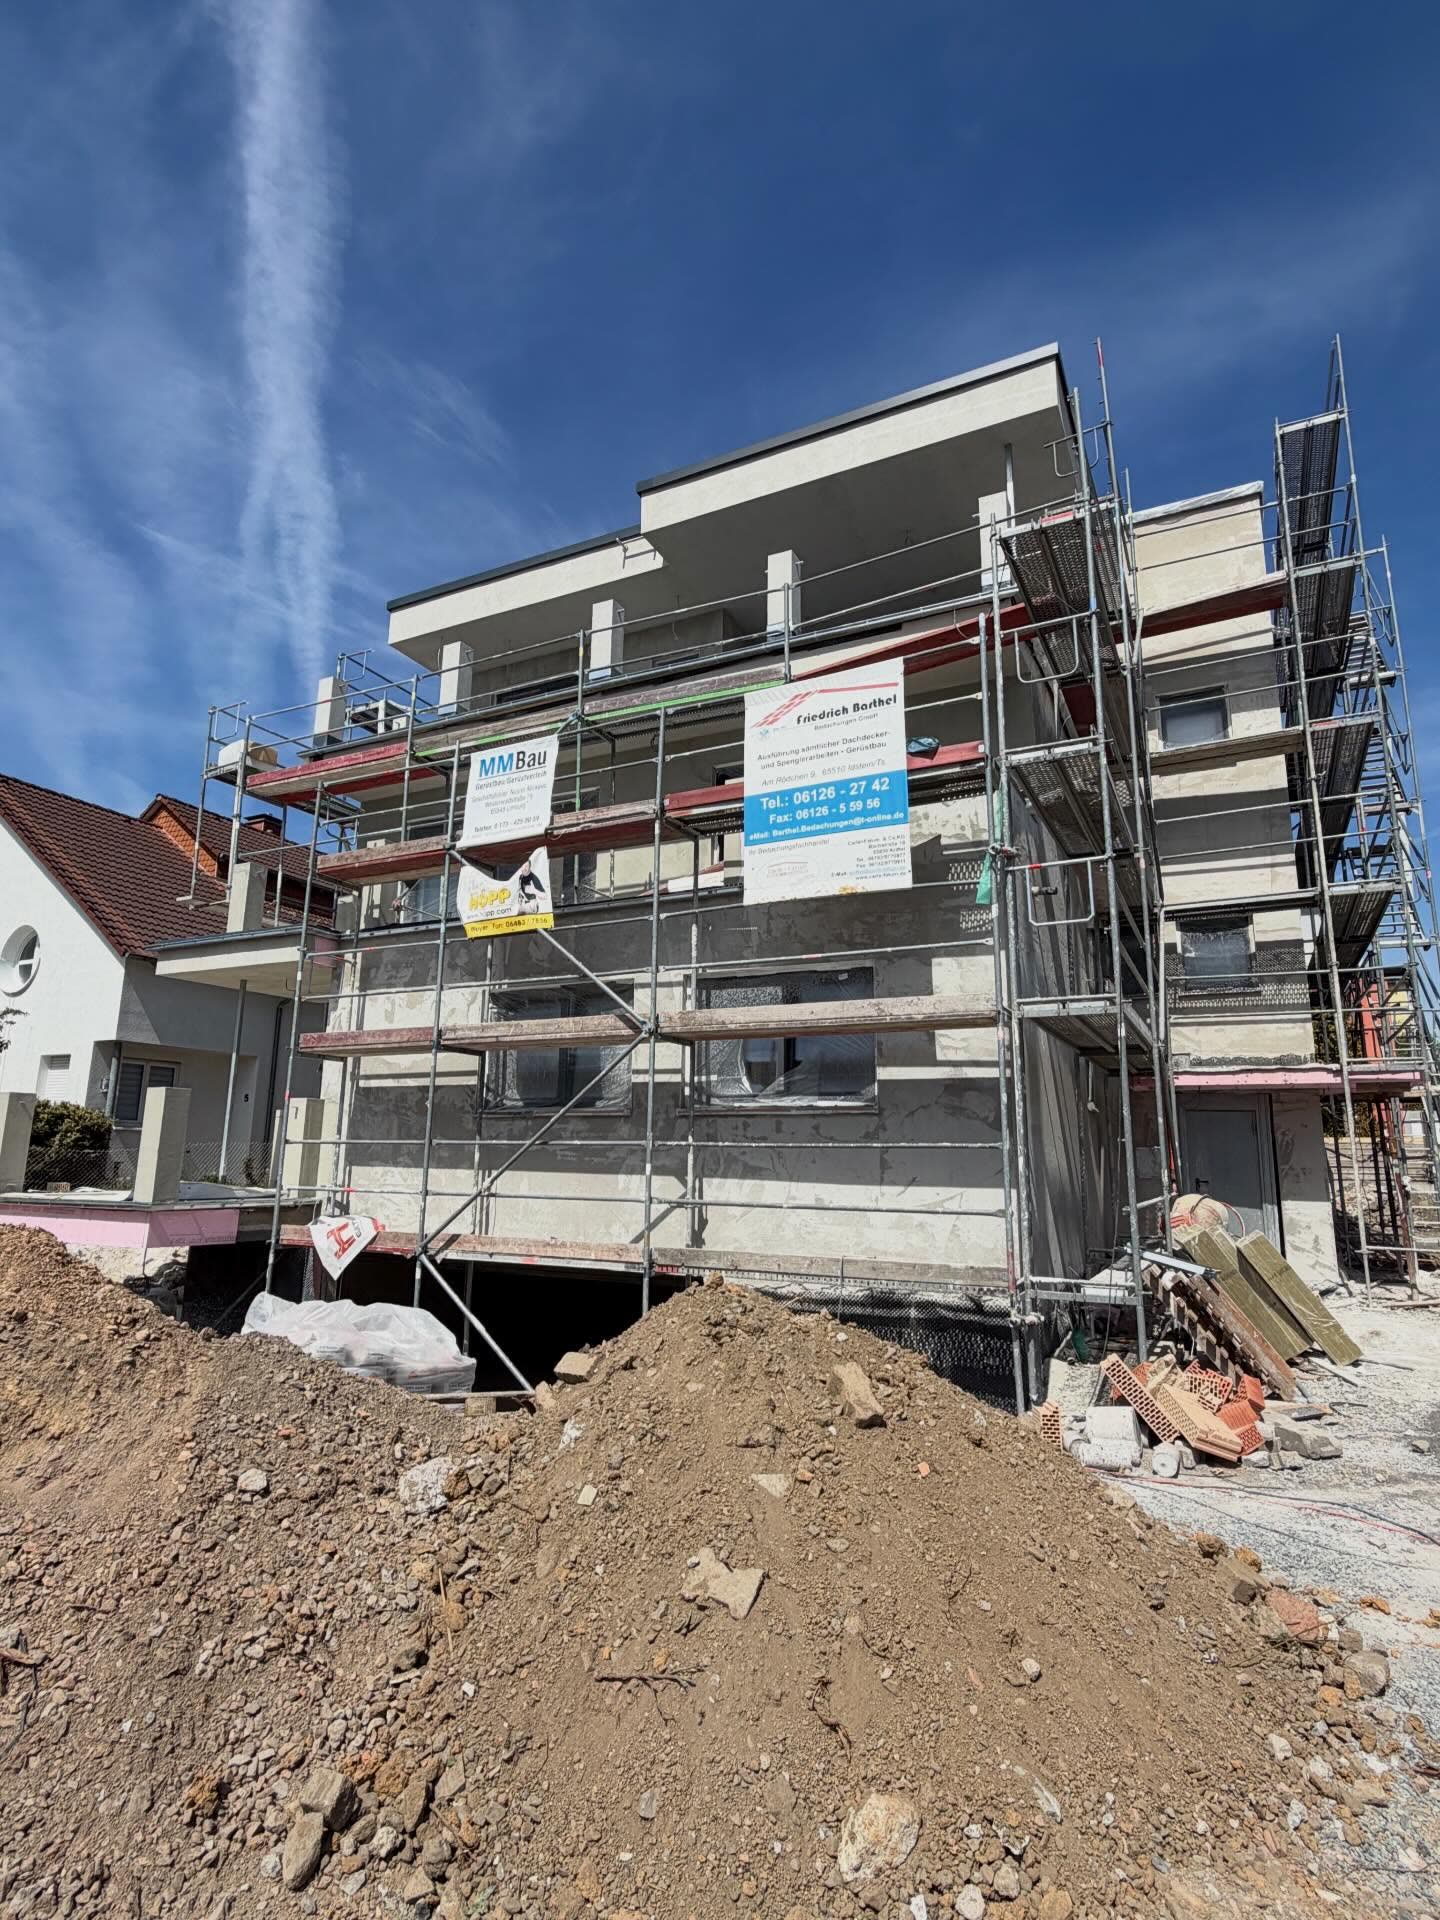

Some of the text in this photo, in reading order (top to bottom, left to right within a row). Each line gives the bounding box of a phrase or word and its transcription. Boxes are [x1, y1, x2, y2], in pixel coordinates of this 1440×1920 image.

[797, 694, 897, 725] Friedrich Barthel
[761, 762, 774, 770] und
[846, 742, 887, 754] Gerüstbau
[760, 795, 789, 810] Tel.:
[793, 786, 836, 804] 06126
[849, 781, 867, 796] 27
[871, 777, 890, 792] 42
[769, 813, 793, 824] Fax:
[795, 805, 829, 820] 06126
[839, 802, 846, 813] 5
[849, 800, 863, 811] 59
[866, 797, 881, 809] 56
[243, 1093, 249, 1102] 5
